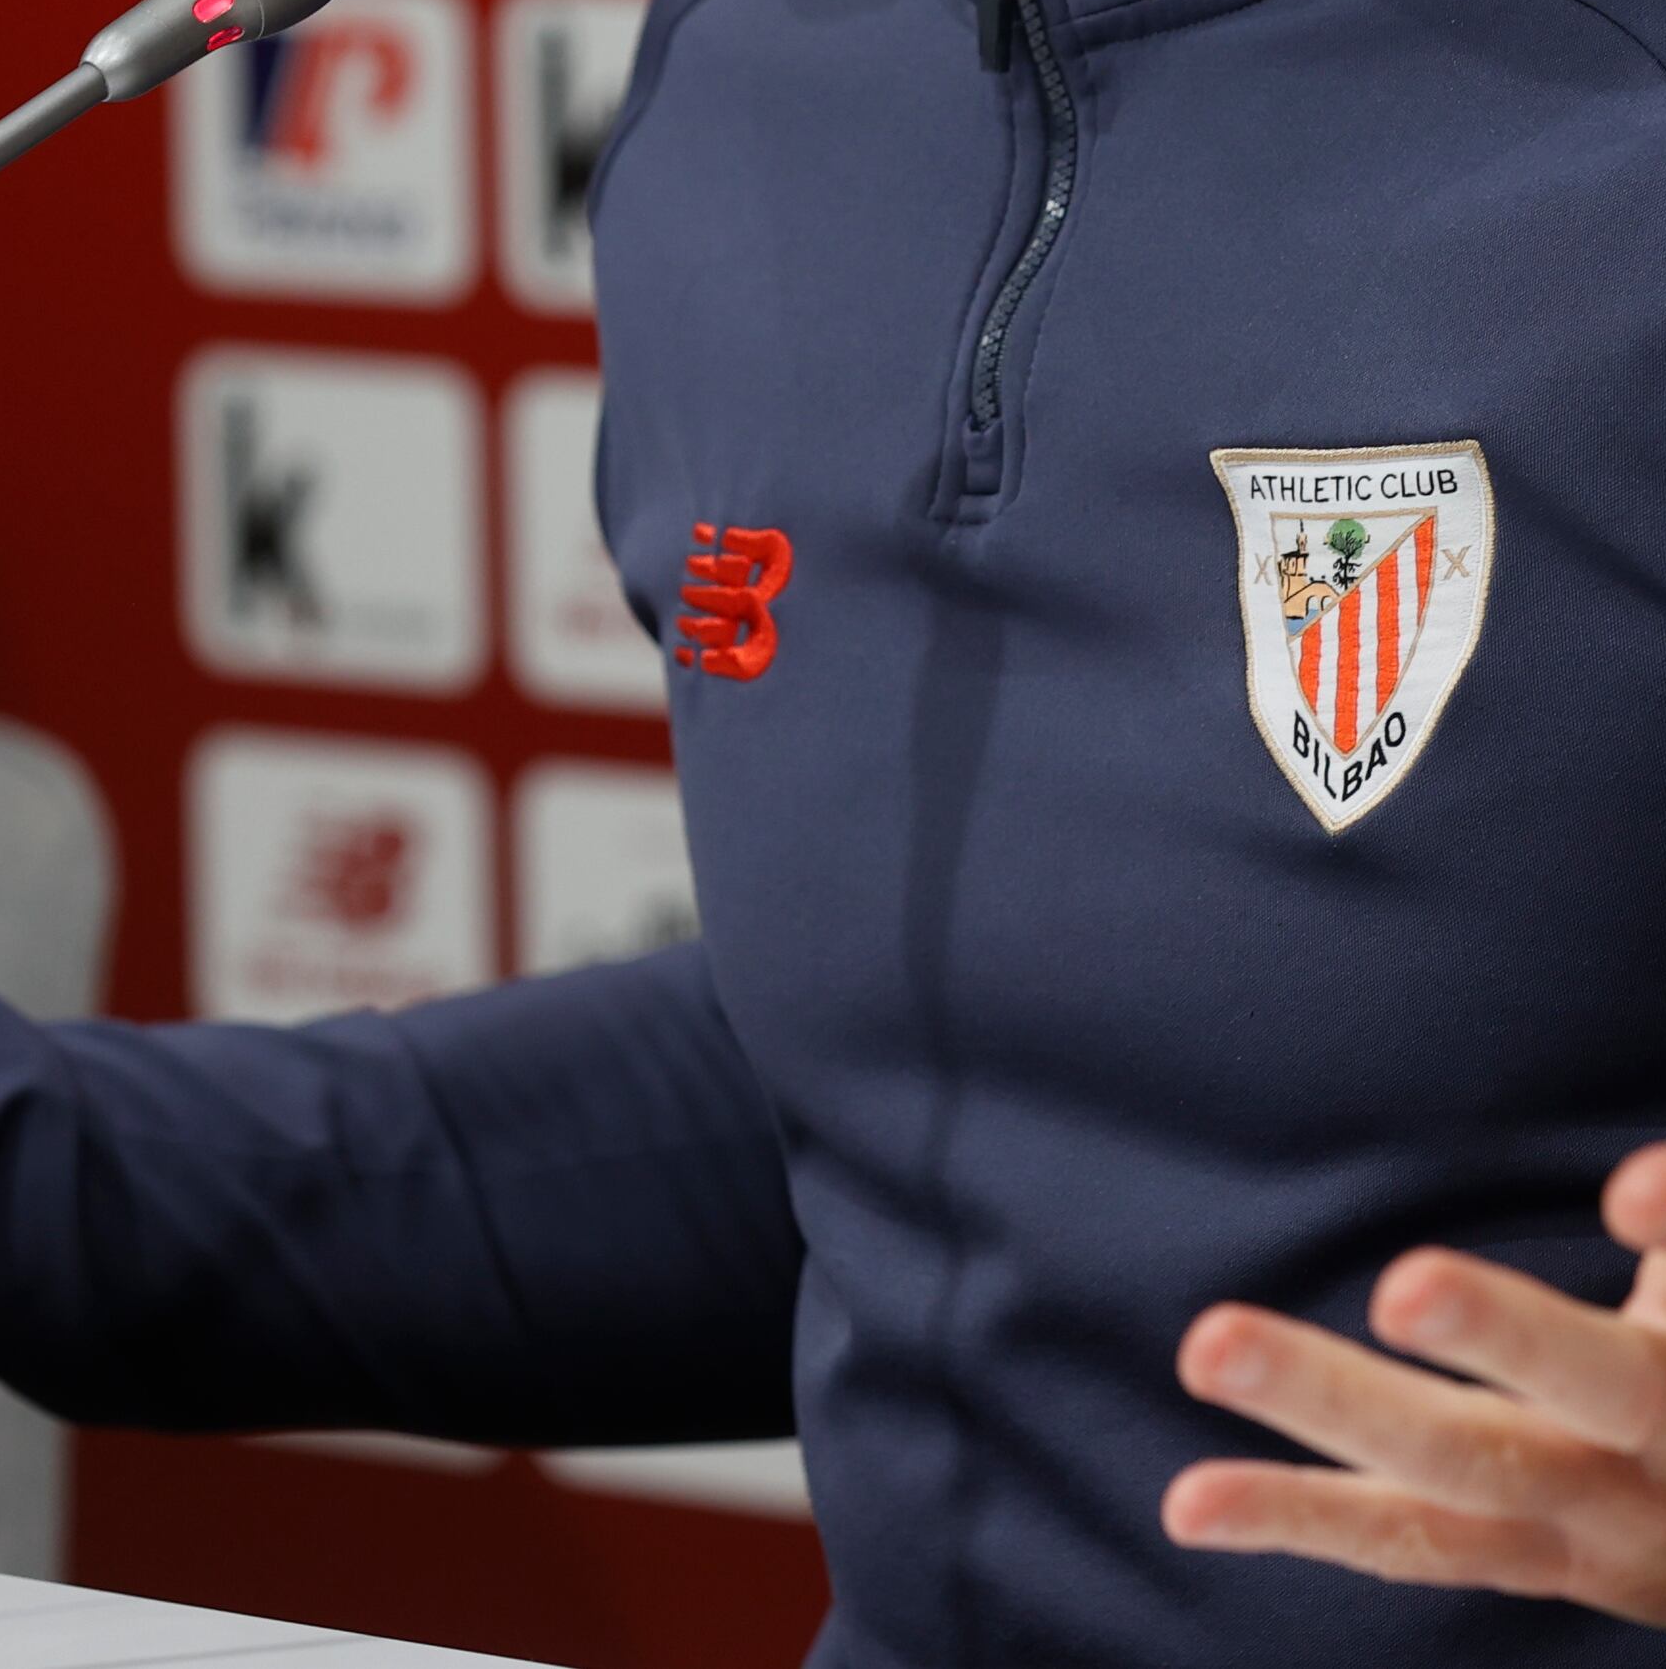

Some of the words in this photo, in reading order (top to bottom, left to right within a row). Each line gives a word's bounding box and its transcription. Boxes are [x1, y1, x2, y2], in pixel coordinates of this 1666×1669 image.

[1249, 474, 1372, 504] ATHLETIC
[1379, 468, 1459, 500] CLUB
[1291, 710, 1407, 803] BILBAO
